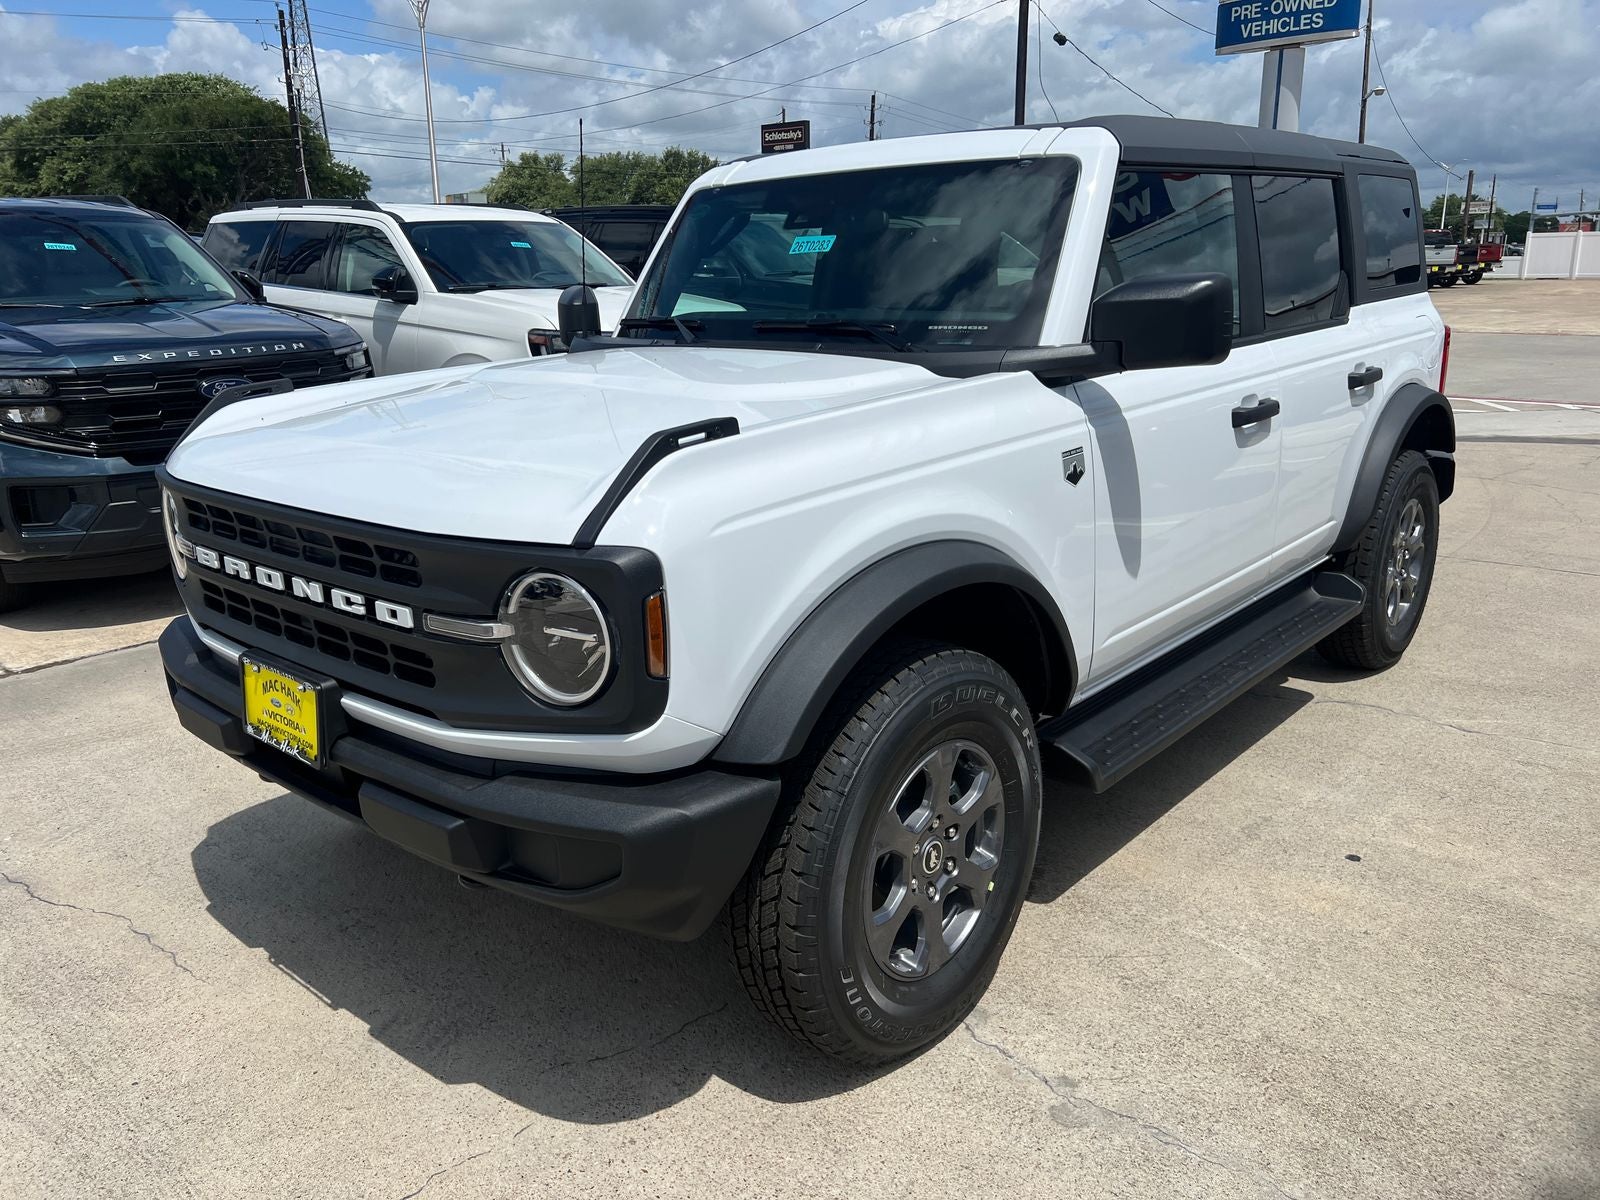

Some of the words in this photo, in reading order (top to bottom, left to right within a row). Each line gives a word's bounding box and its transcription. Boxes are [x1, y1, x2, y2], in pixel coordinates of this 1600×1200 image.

[1231, 0, 1337, 22] PRE-OWNED
[1241, 13, 1324, 38] VEHICLES
[764, 129, 802, 141] Schlotzsky's
[792, 239, 832, 253] 26T0283
[112, 342, 305, 362] EXPEDITION
[195, 546, 414, 629] BRONCO
[262, 679, 280, 695] MAC
[280, 680, 302, 712] HAIK
[267, 709, 300, 732] VICTORIA
[931, 684, 1034, 751] DUELER
[260, 730, 279, 748] Mac
[280, 740, 301, 757] Haik
